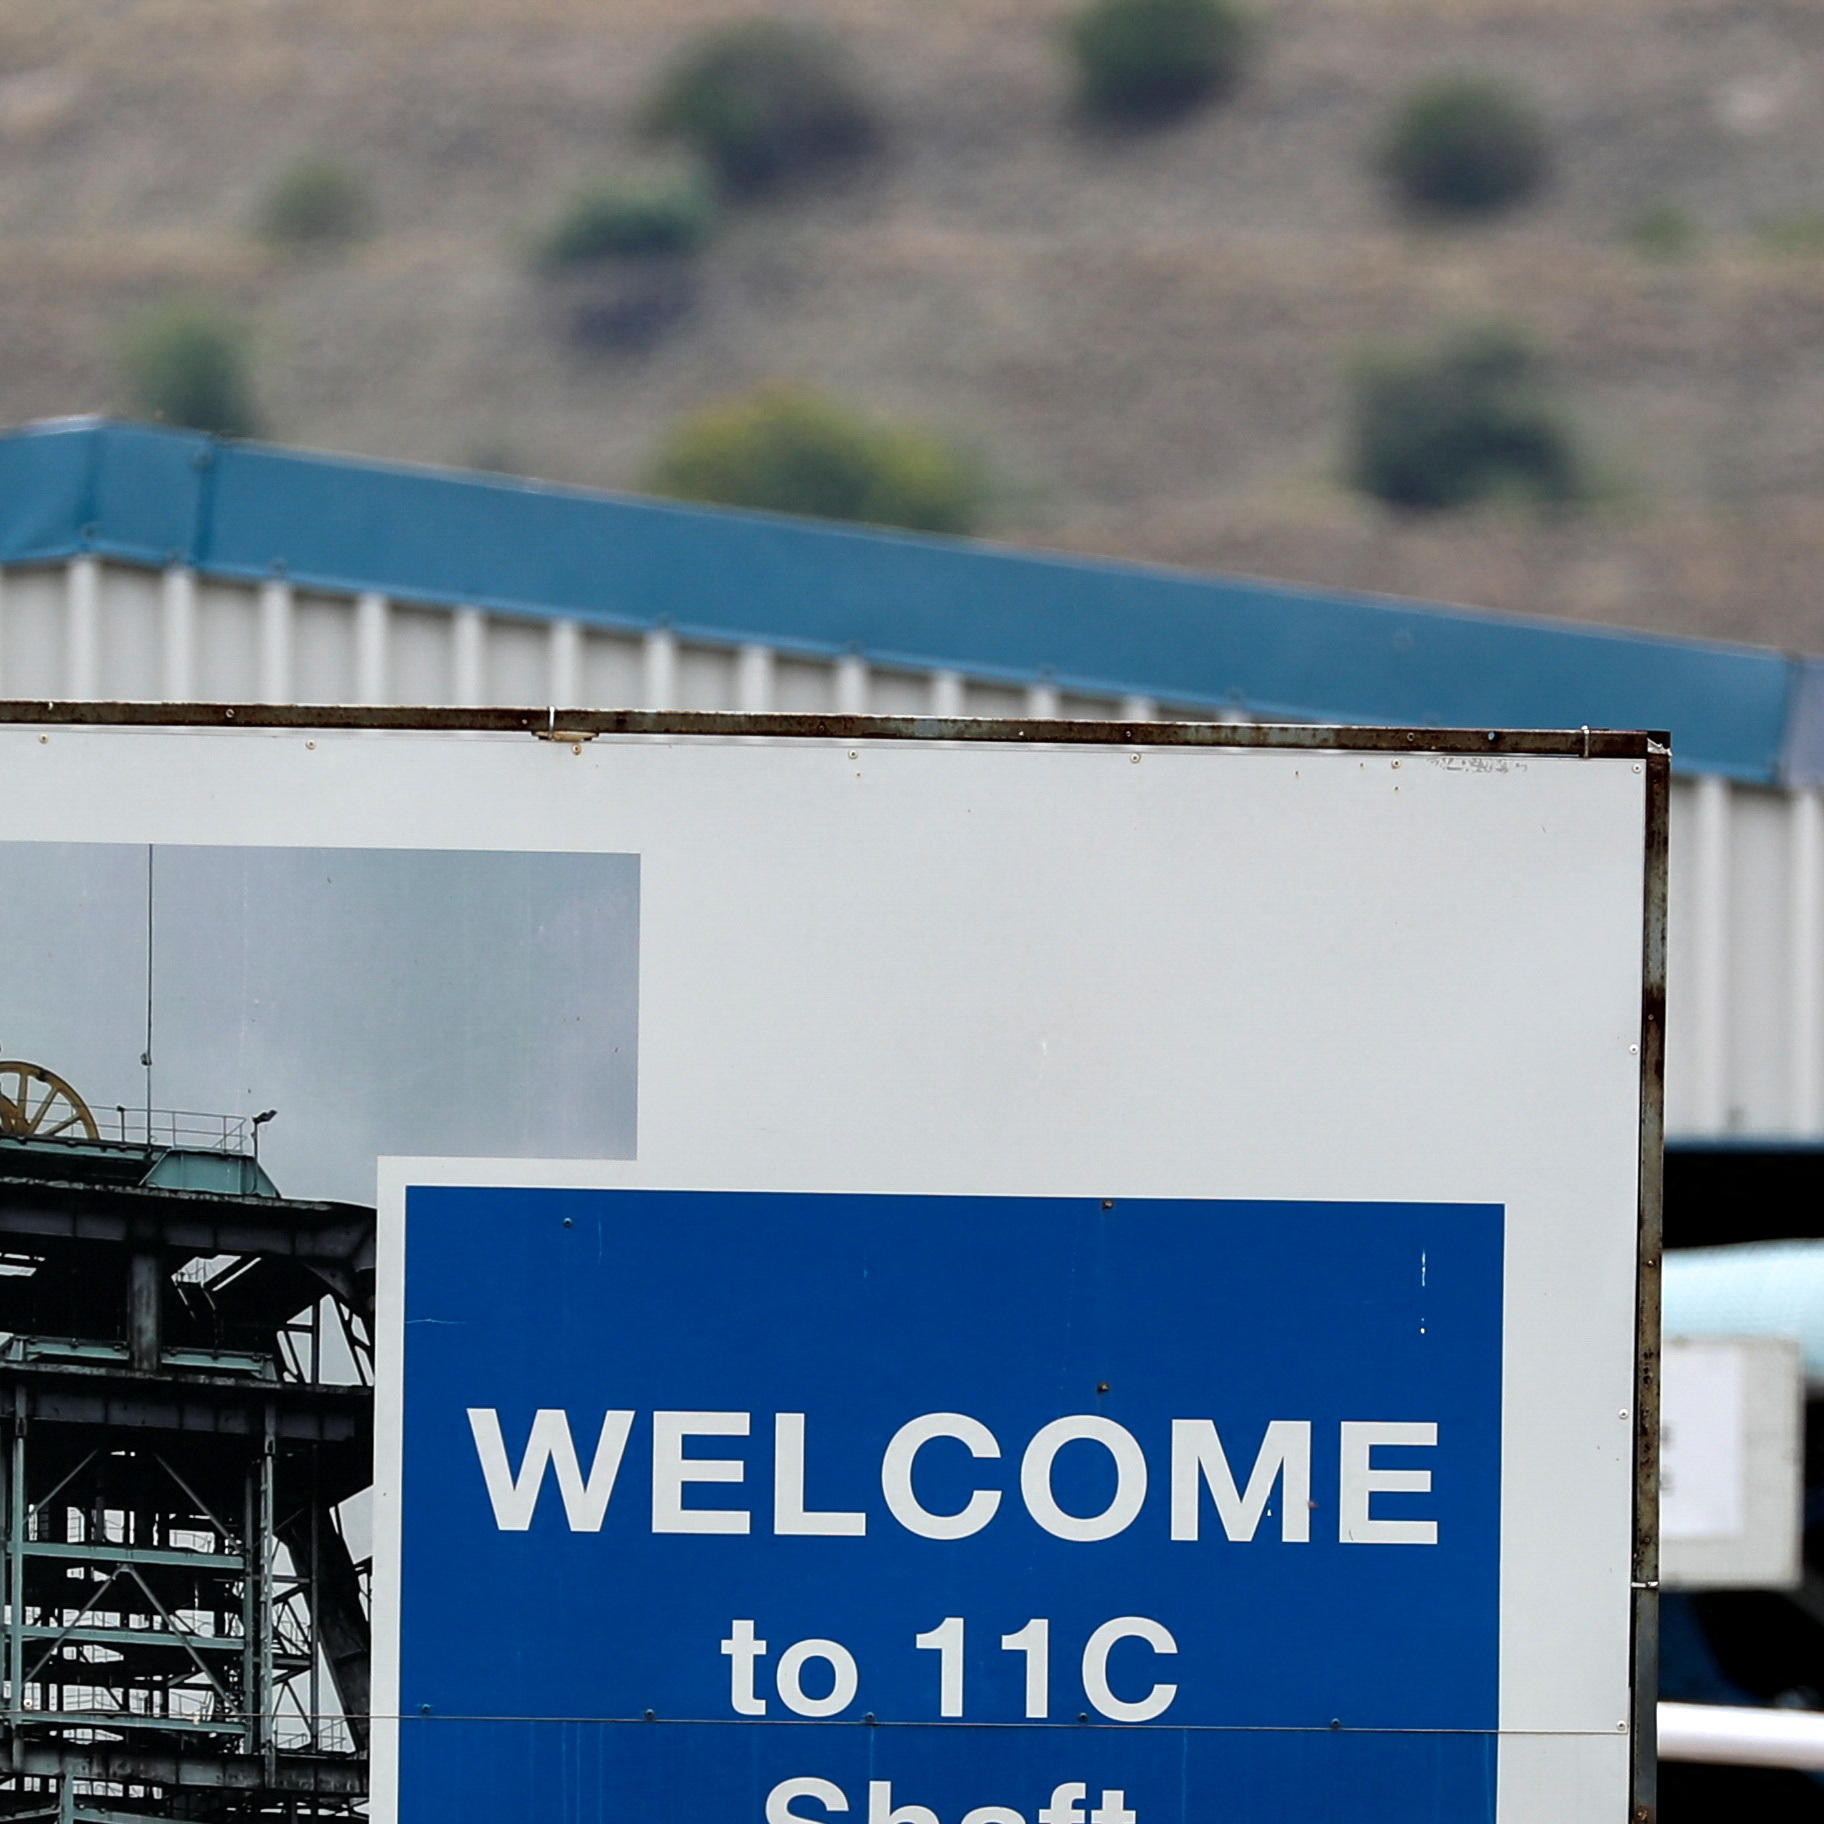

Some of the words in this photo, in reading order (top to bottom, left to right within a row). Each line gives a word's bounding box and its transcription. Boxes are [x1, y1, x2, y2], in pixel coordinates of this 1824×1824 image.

[466, 1407, 1439, 1545] WELCOME
[720, 1619, 858, 1718] to
[915, 1616, 1179, 1722] 11C
